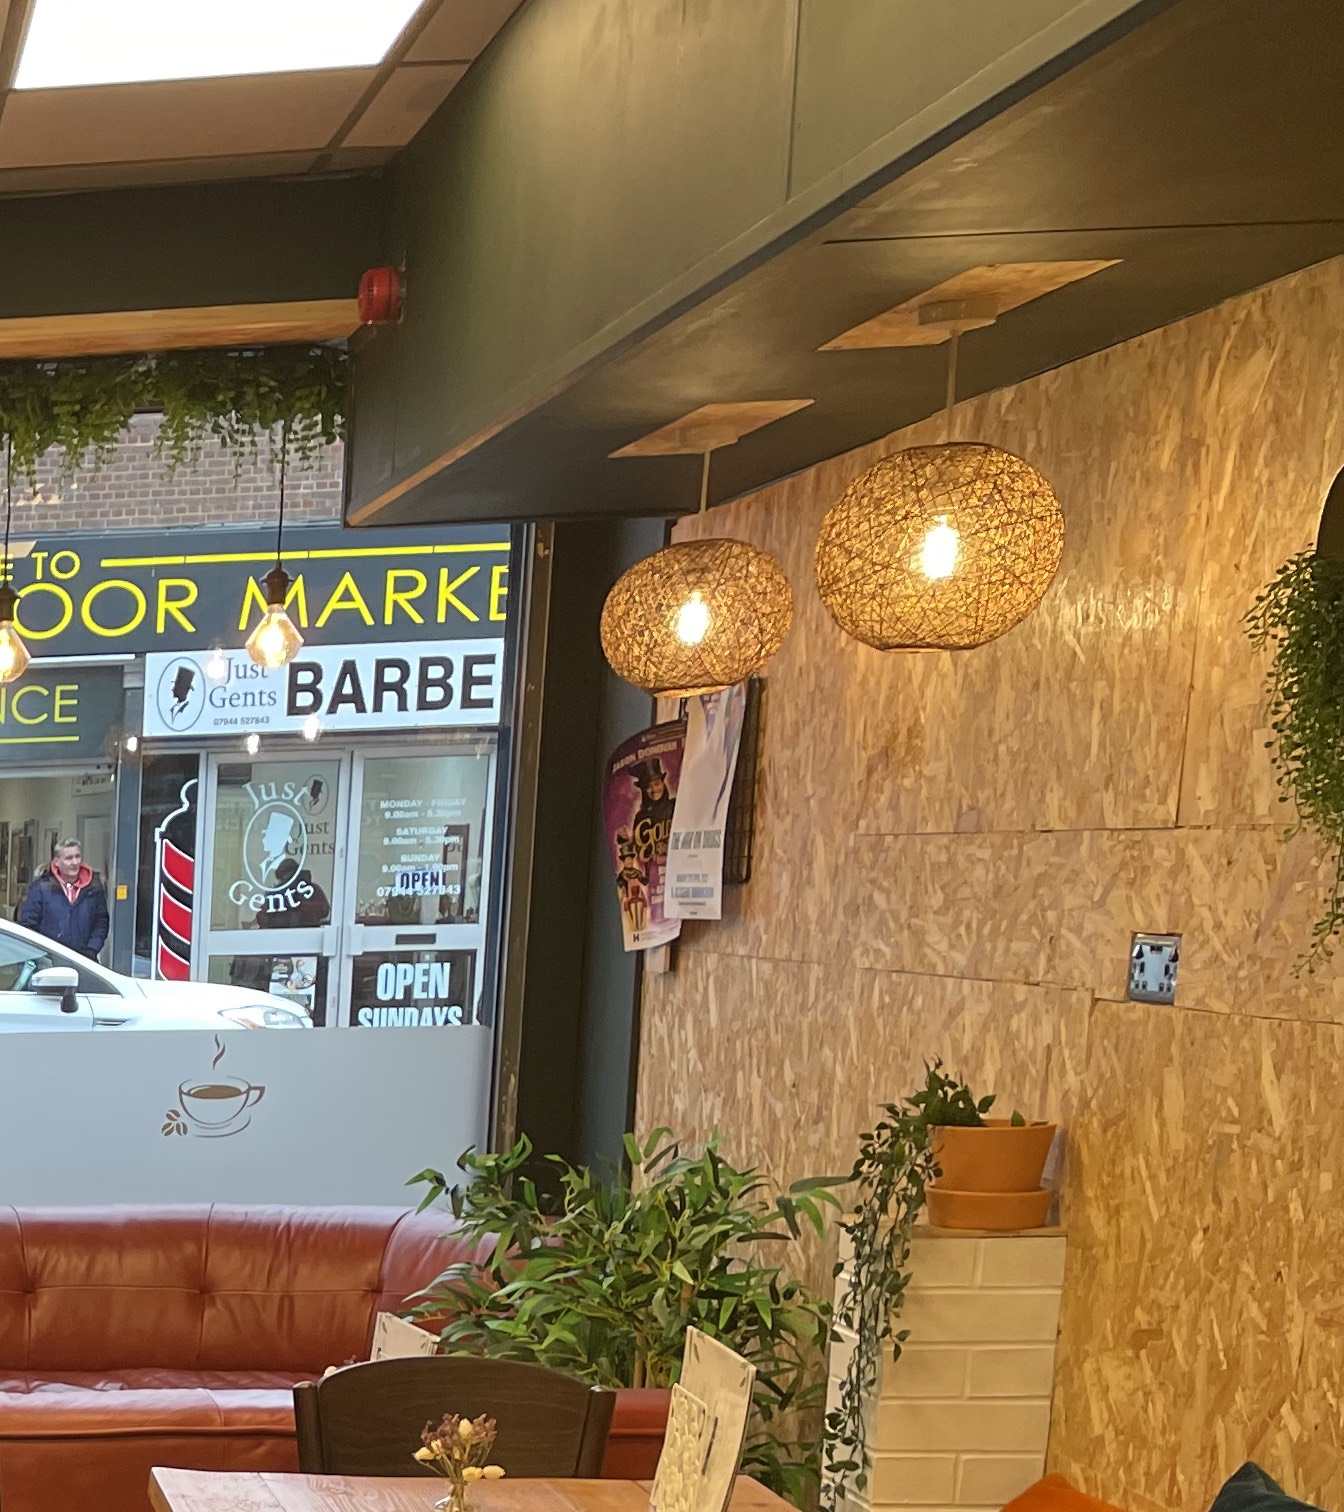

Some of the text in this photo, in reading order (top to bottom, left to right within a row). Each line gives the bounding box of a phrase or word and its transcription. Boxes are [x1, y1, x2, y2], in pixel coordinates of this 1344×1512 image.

[32, 550, 81, 580] TO
[237, 565, 510, 631] MARKE
[225, 657, 270, 682] Just
[286, 654, 497, 717] BARBE
[209, 686, 278, 710] Gents
[242, 781, 310, 810] Just
[380, 799, 423, 809] MONDAY
[297, 821, 330, 838] Just
[396, 826, 449, 836] SATURDAY
[286, 839, 336, 856] Gents
[400, 853, 441, 863] SUNDAY
[400, 872, 440, 889] OPEN
[229, 880, 315, 913] Gents
[376, 962, 451, 1001] OPEN
[357, 1005, 463, 1028] SUNDAYS
